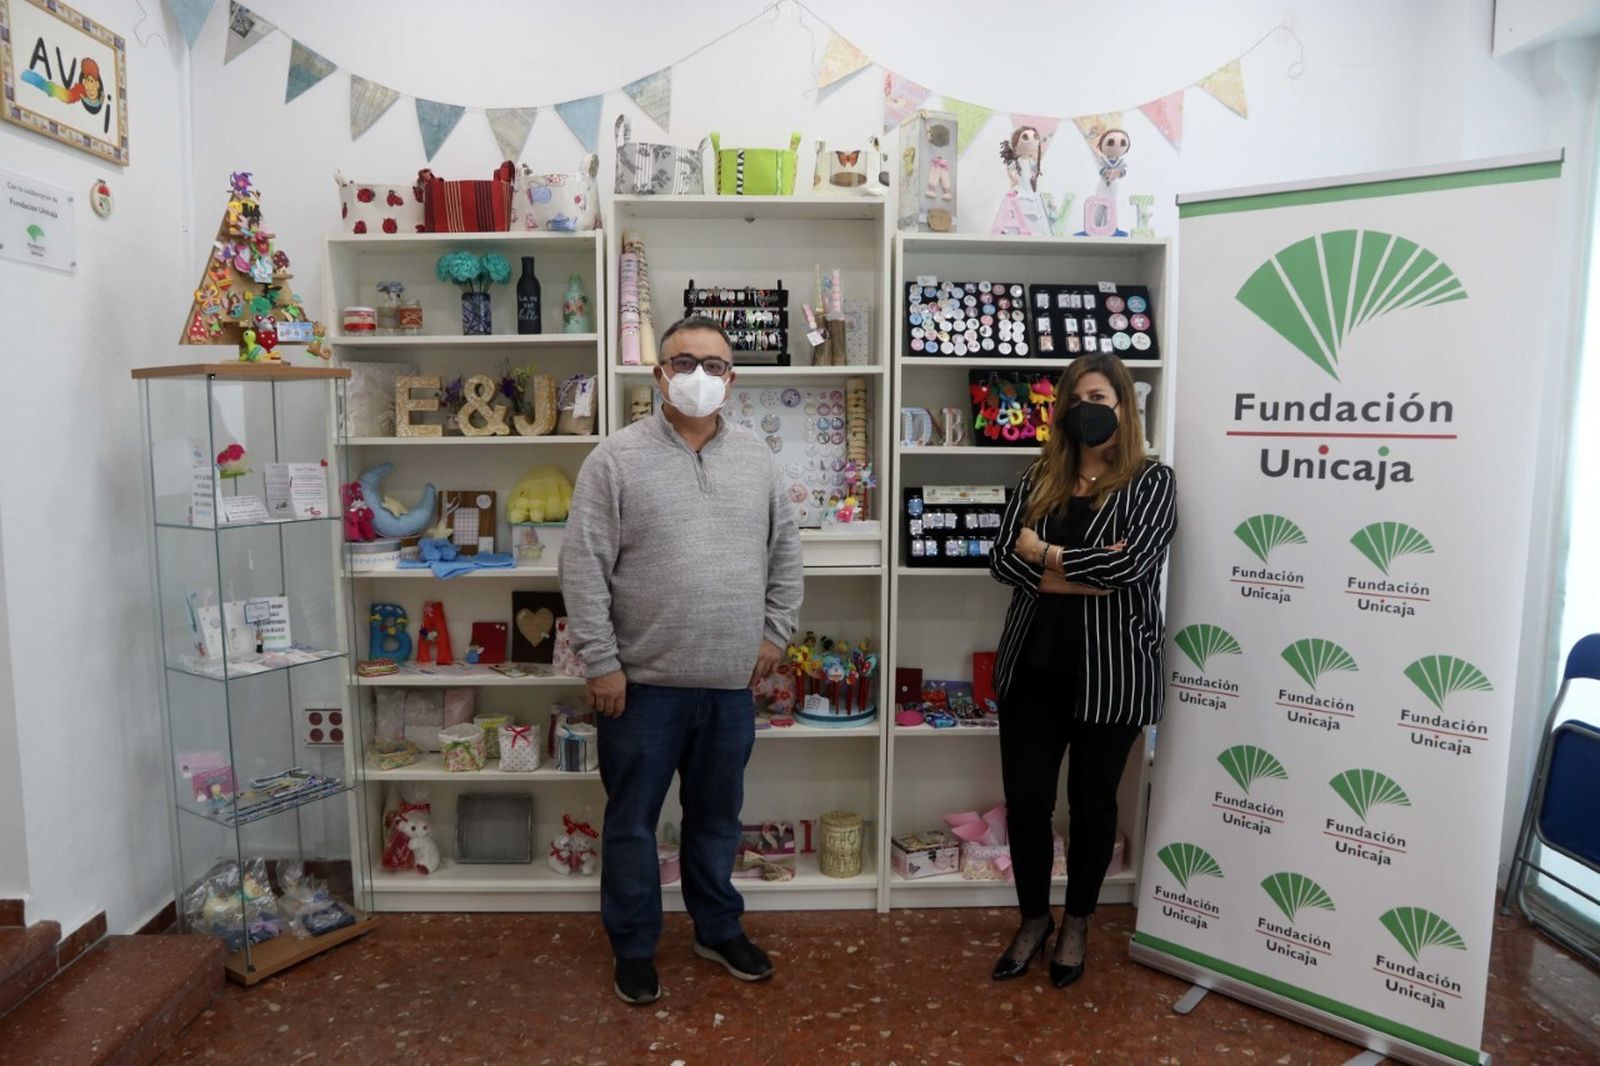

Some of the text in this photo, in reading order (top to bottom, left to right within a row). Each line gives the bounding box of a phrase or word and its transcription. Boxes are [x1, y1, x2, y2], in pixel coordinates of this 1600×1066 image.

[1235, 392, 1453, 422] Fundación
[1261, 445, 1414, 490] Unicaja
[1233, 566, 1304, 582] Fundación
[1241, 586, 1291, 603] Unicaja
[1348, 577, 1430, 595] Fundación
[1358, 599, 1415, 617] Unicaja
[1171, 672, 1240, 691] Fundación
[1179, 691, 1227, 710] Unicaja
[1279, 689, 1354, 711] Fundación
[1288, 711, 1340, 731] Unicaja
[1401, 709, 1488, 734] Fundación
[1411, 733, 1472, 755] Unicaja
[1215, 792, 1284, 816] Fundación
[1223, 813, 1271, 834] Unicaja
[1327, 819, 1406, 847] Fundación
[1336, 841, 1391, 865] Unicaja
[1154, 886, 1219, 913] Fundación
[1163, 906, 1208, 928] Unicaja
[1257, 918, 1331, 949] Fundación
[1267, 940, 1317, 965] Unicaja
[1375, 955, 1461, 993] Fundación
[1386, 979, 1446, 1009] Unicaja
